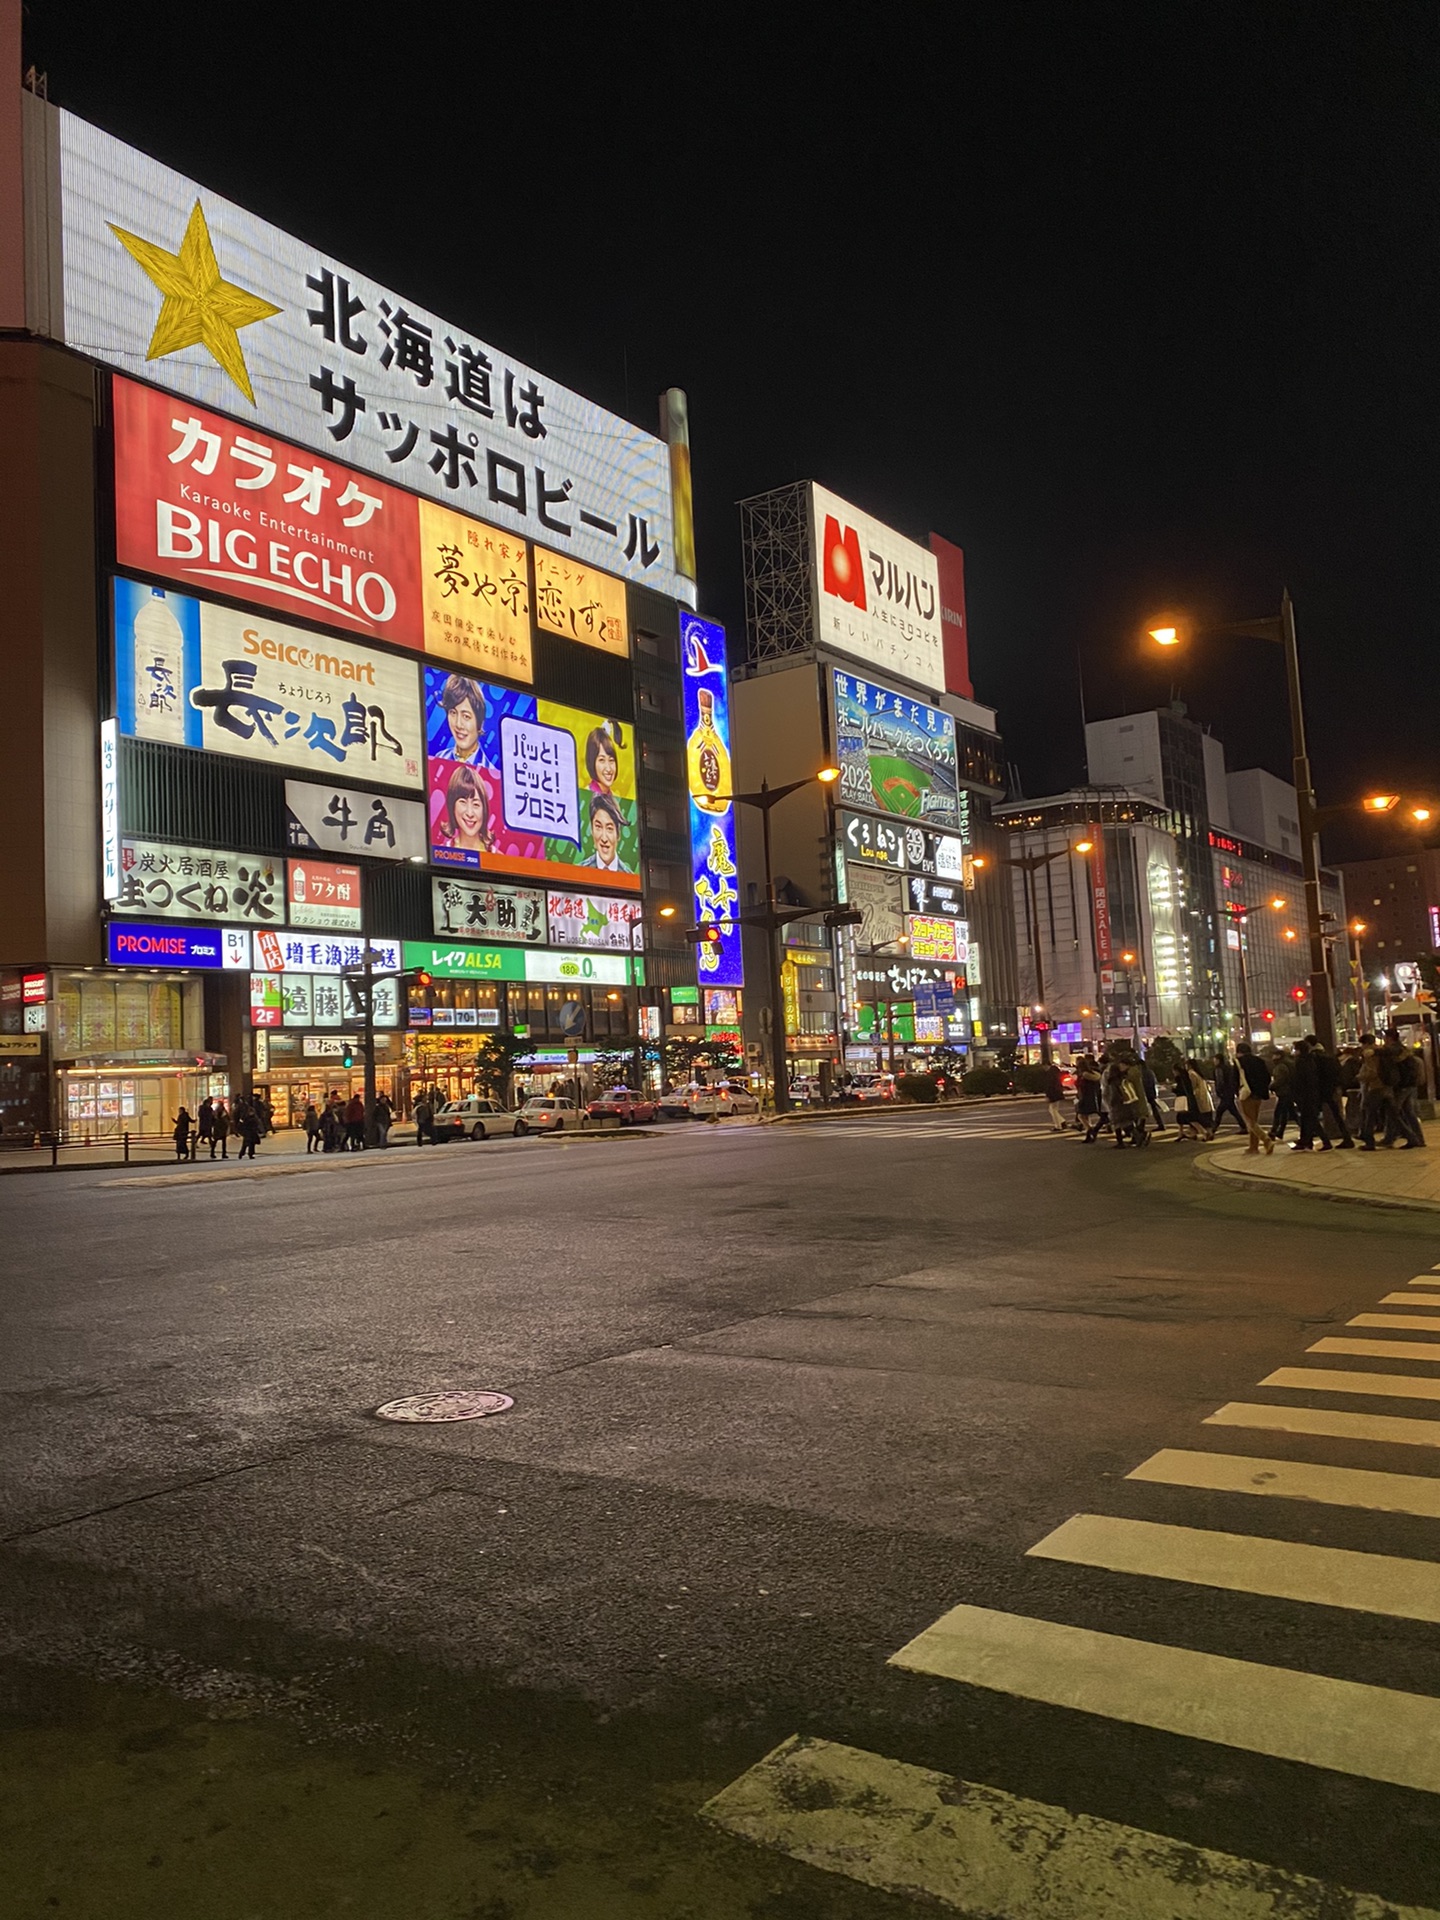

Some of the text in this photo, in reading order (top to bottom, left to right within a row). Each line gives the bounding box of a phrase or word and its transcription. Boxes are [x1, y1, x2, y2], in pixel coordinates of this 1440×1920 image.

[305, 266, 548, 439] 北海道は
[167, 417, 383, 527] カラオケ
[309, 366, 661, 569] サッポロビール
[180, 483, 375, 564] Karaoke Entertainment
[156, 499, 397, 622] BIG ECHO
[868, 549, 935, 621] マルハン
[242, 628, 376, 686] Seicomart
[833, 616, 935, 673] 新しいパチンコへ
[145, 657, 176, 714] 長次郎
[278, 682, 332, 705] ちょうじろう
[190, 660, 403, 763] 長次郎
[836, 673, 954, 737] 世界がまだ見ぬ
[840, 762, 873, 793] 2023
[515, 794, 569, 825] プロミス
[841, 787, 874, 805] PLAY BALL
[920, 788, 956, 814] FIGHTERS
[321, 794, 396, 849] 牛角
[138, 852, 230, 880] 炭火居酒屋
[434, 849, 466, 862] PROMISE
[311, 881, 351, 901] ワタ酎
[466, 895, 517, 929] 大助
[549, 895, 586, 919] 北海道
[117, 935, 216, 956] PROMISE プロミス
[227, 933, 244, 948] B1
[550, 925, 566, 943] 1F
[258, 932, 284, 970] 本店
[285, 942, 398, 969] 増毛漁港送
[432, 950, 502, 969] レイク ALSA
[251, 977, 279, 994] 増毛
[256, 1008, 275, 1024] 2F
